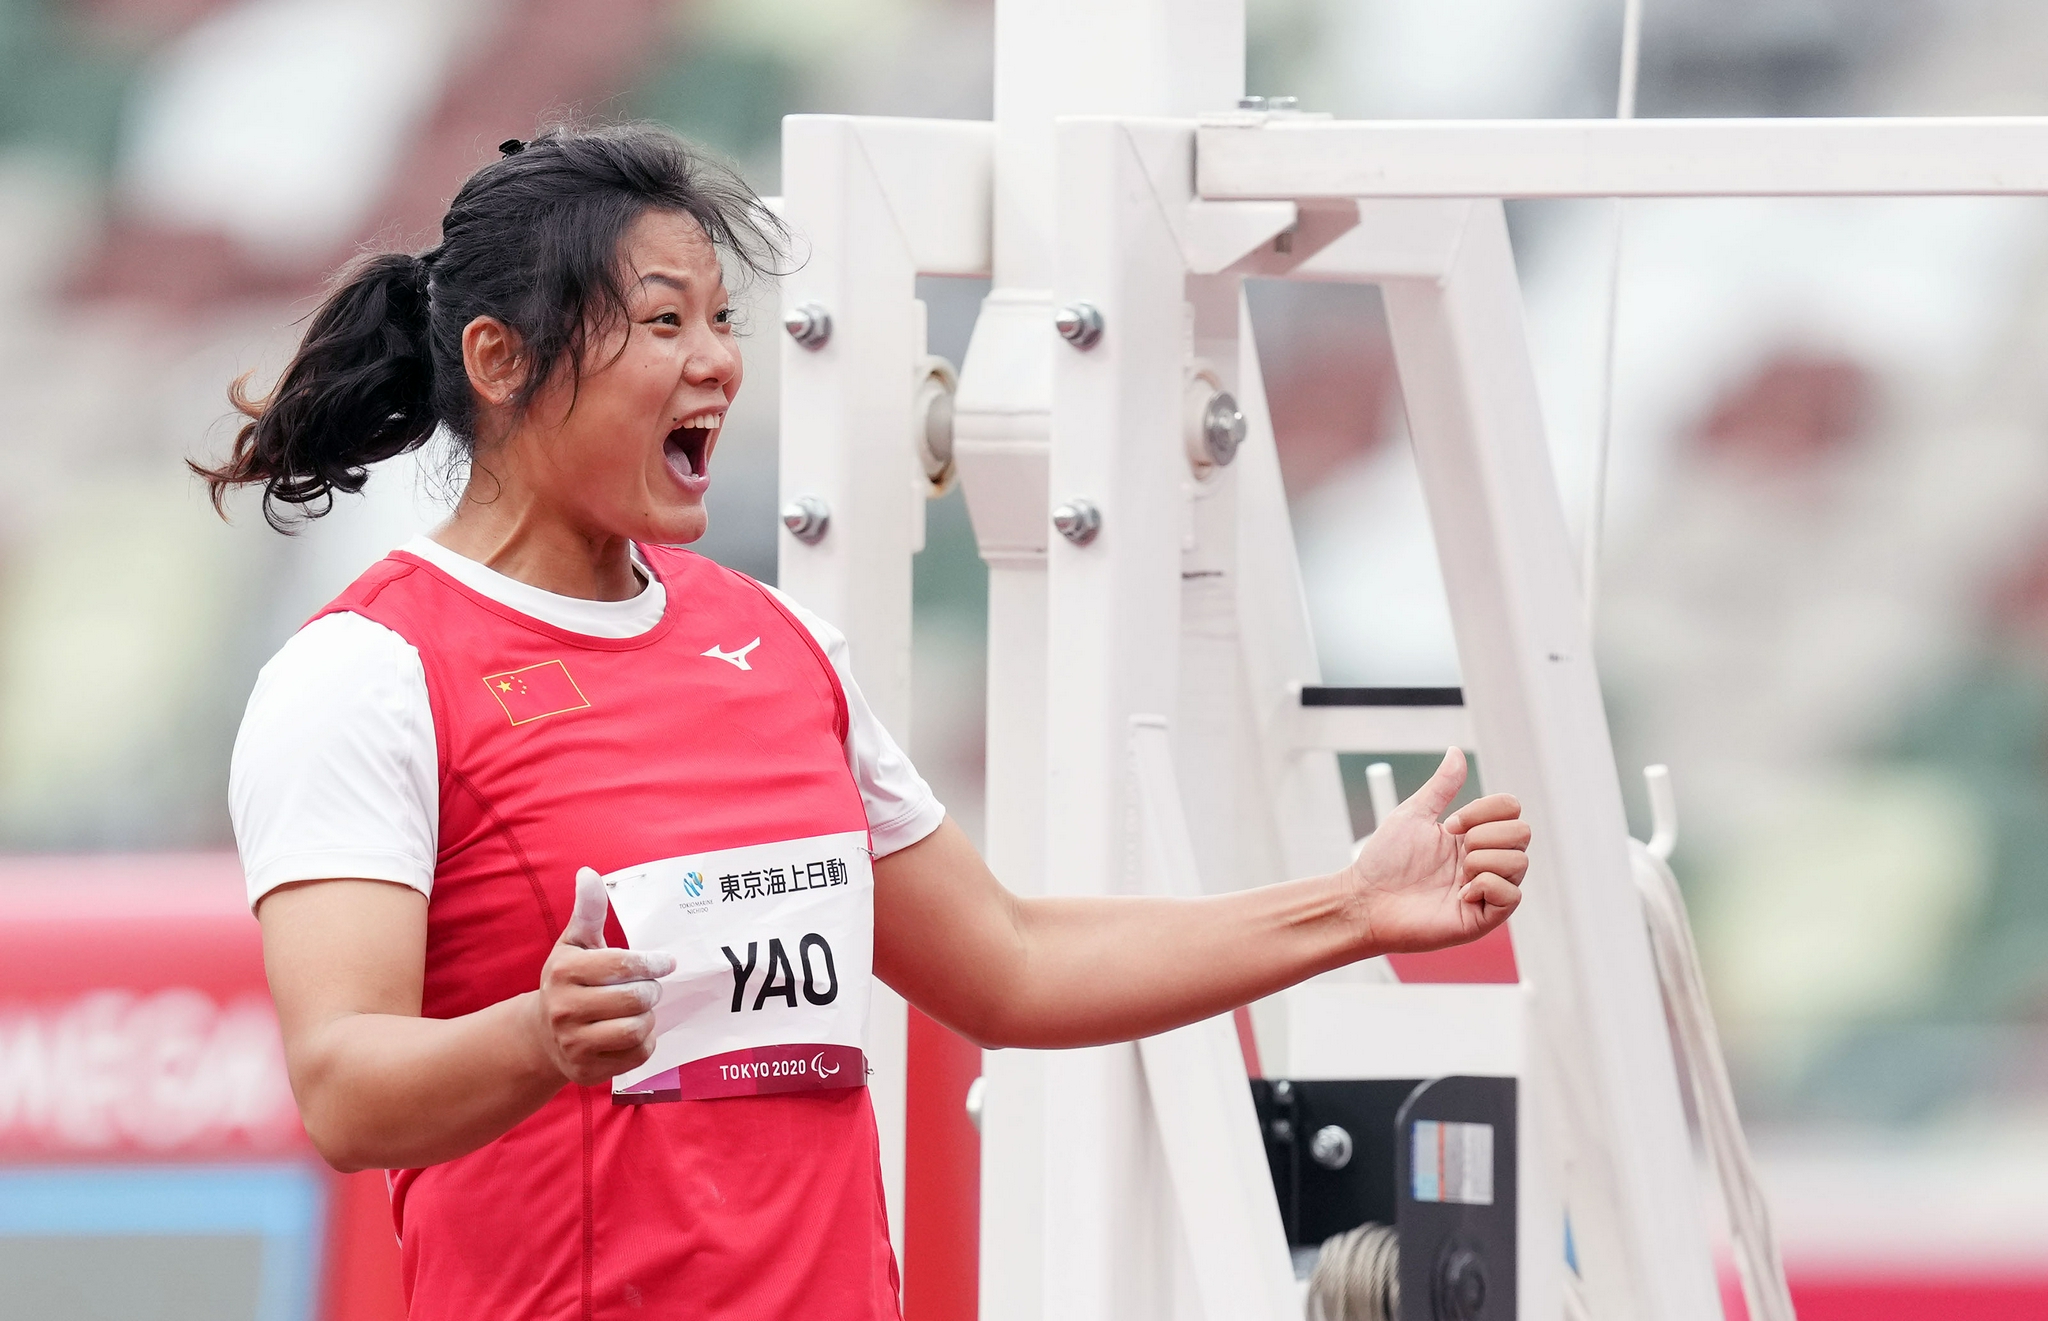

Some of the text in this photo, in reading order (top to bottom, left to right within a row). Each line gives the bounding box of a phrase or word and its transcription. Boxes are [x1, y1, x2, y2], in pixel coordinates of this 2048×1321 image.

[718, 858, 848, 902] 東京海上日動
[721, 932, 838, 1012] YAO
[719, 1060, 807, 1080] TOKYO 2020
